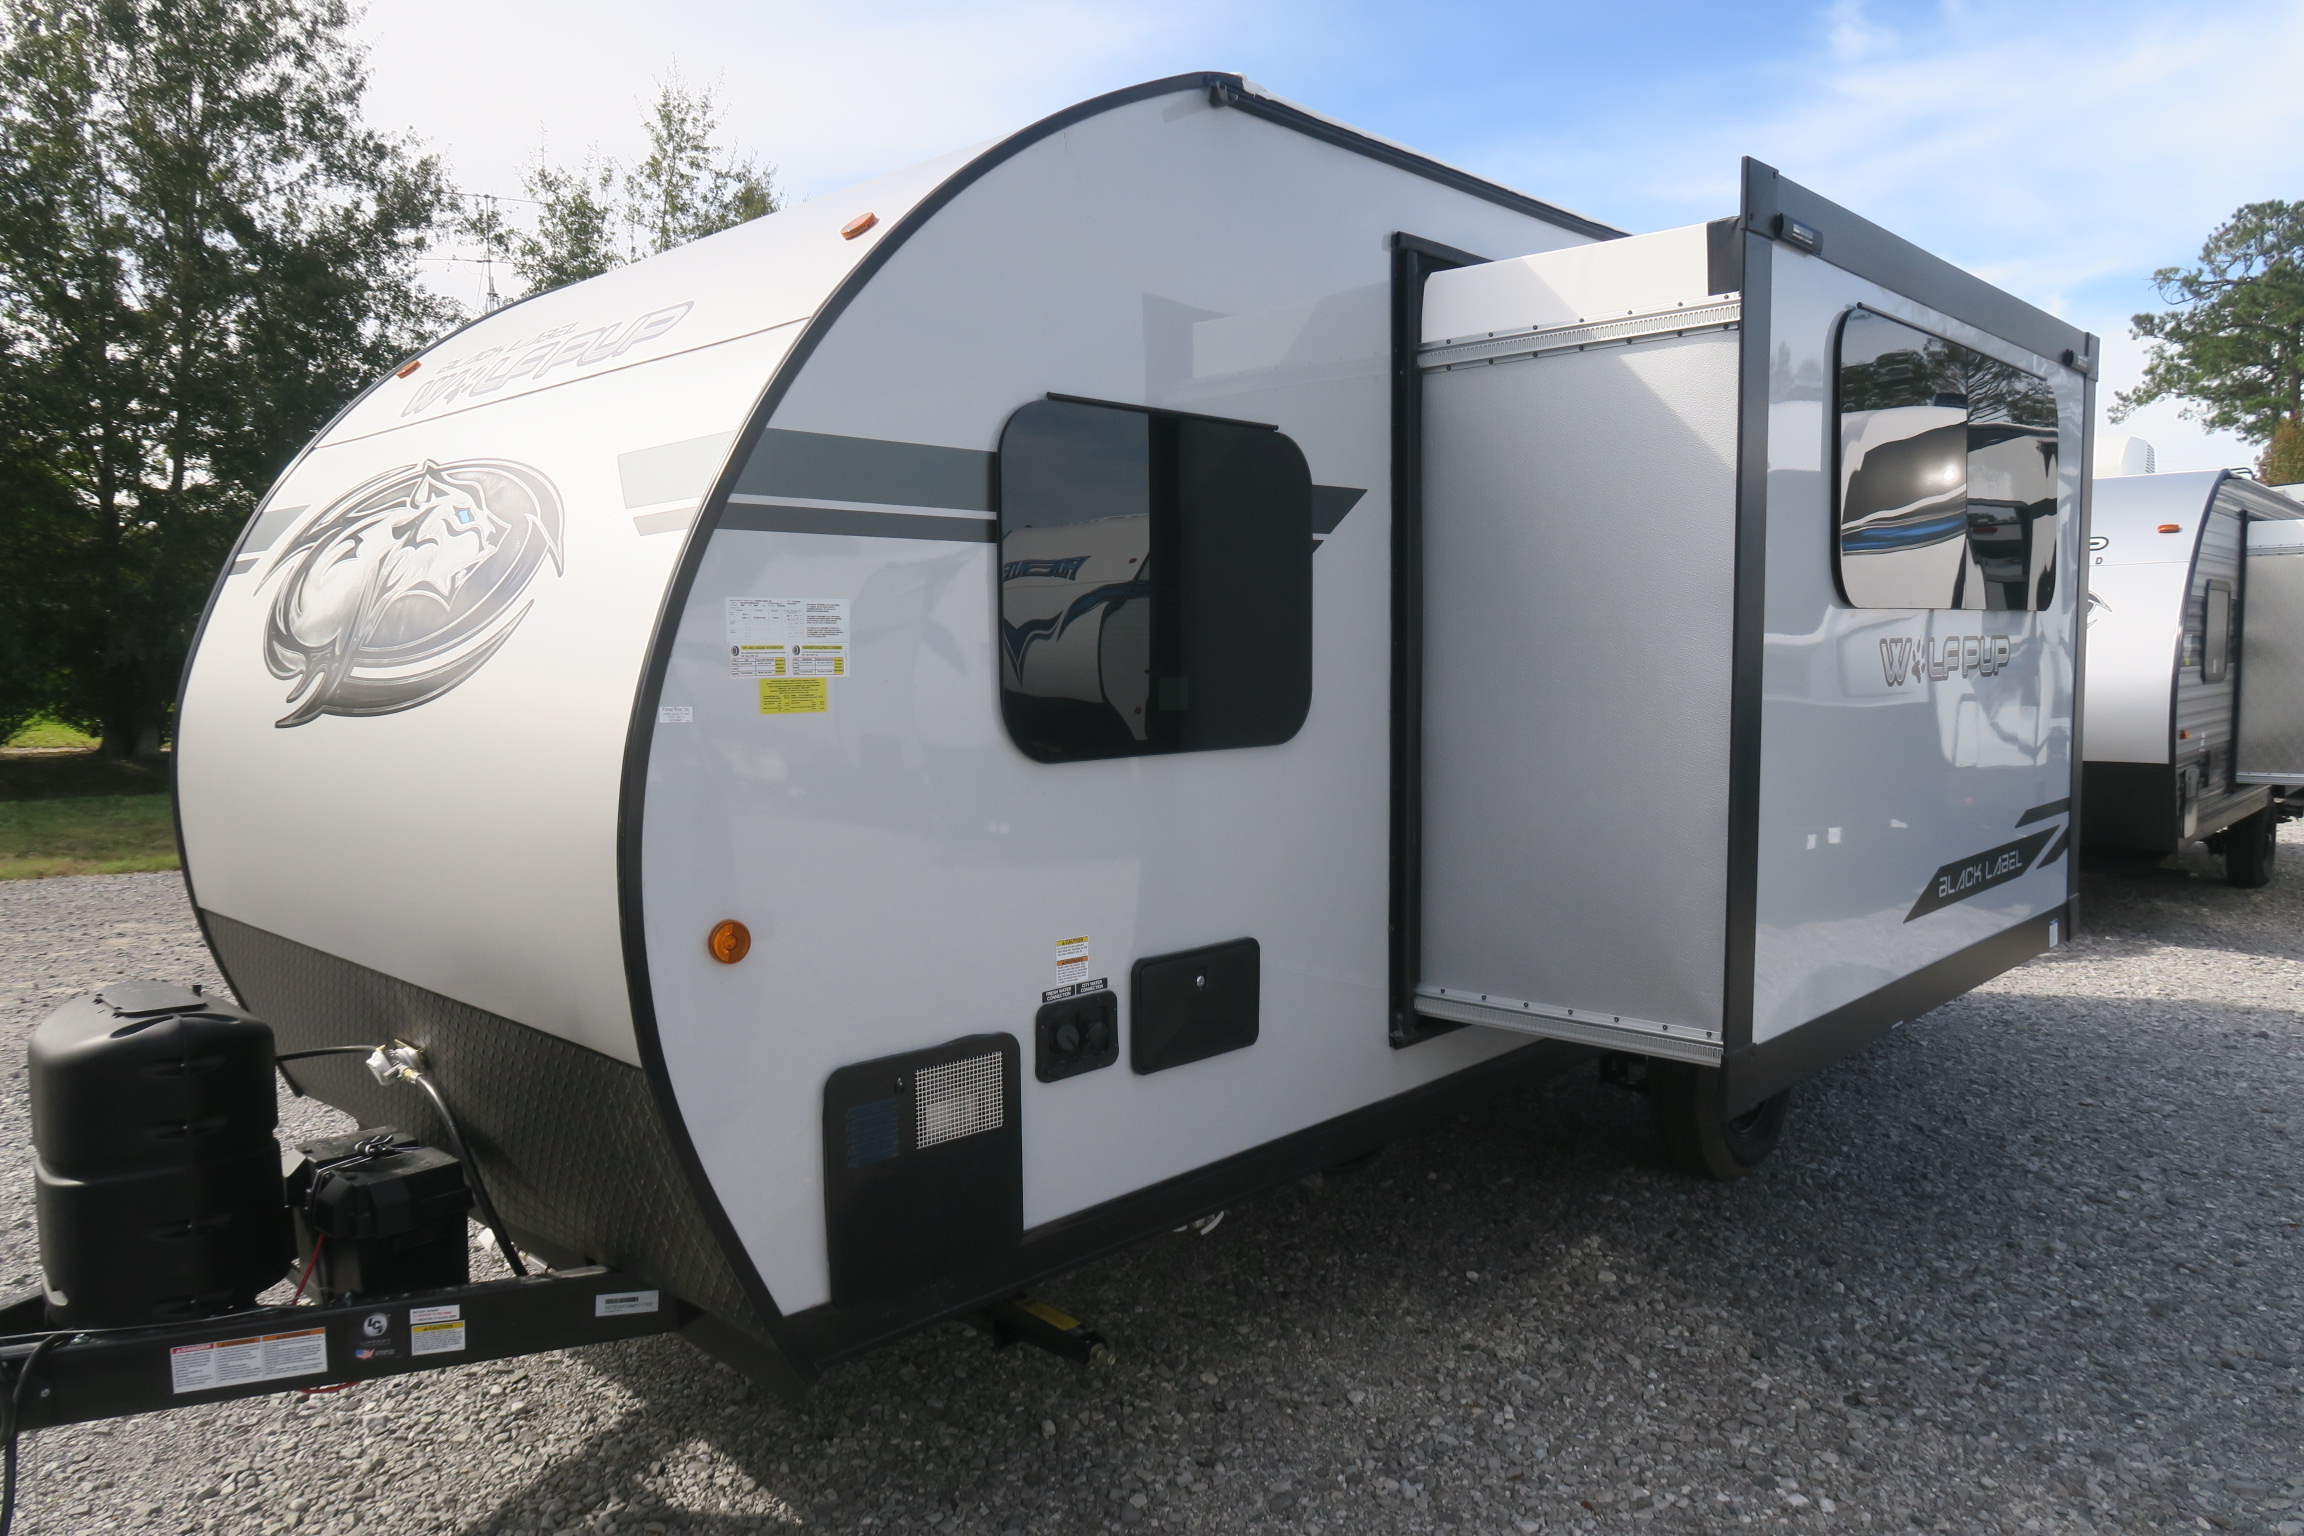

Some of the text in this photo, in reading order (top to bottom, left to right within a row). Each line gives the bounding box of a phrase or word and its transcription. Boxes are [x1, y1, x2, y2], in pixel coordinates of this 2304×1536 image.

[1938, 849, 2023, 898] BLACK LABEL
[1090, 979, 1103, 987] WATER
[1059, 986, 1072, 994] WATER
[1080, 984, 1104, 993] CONNECTION
[1046, 992, 1072, 1001] CONNECTION
